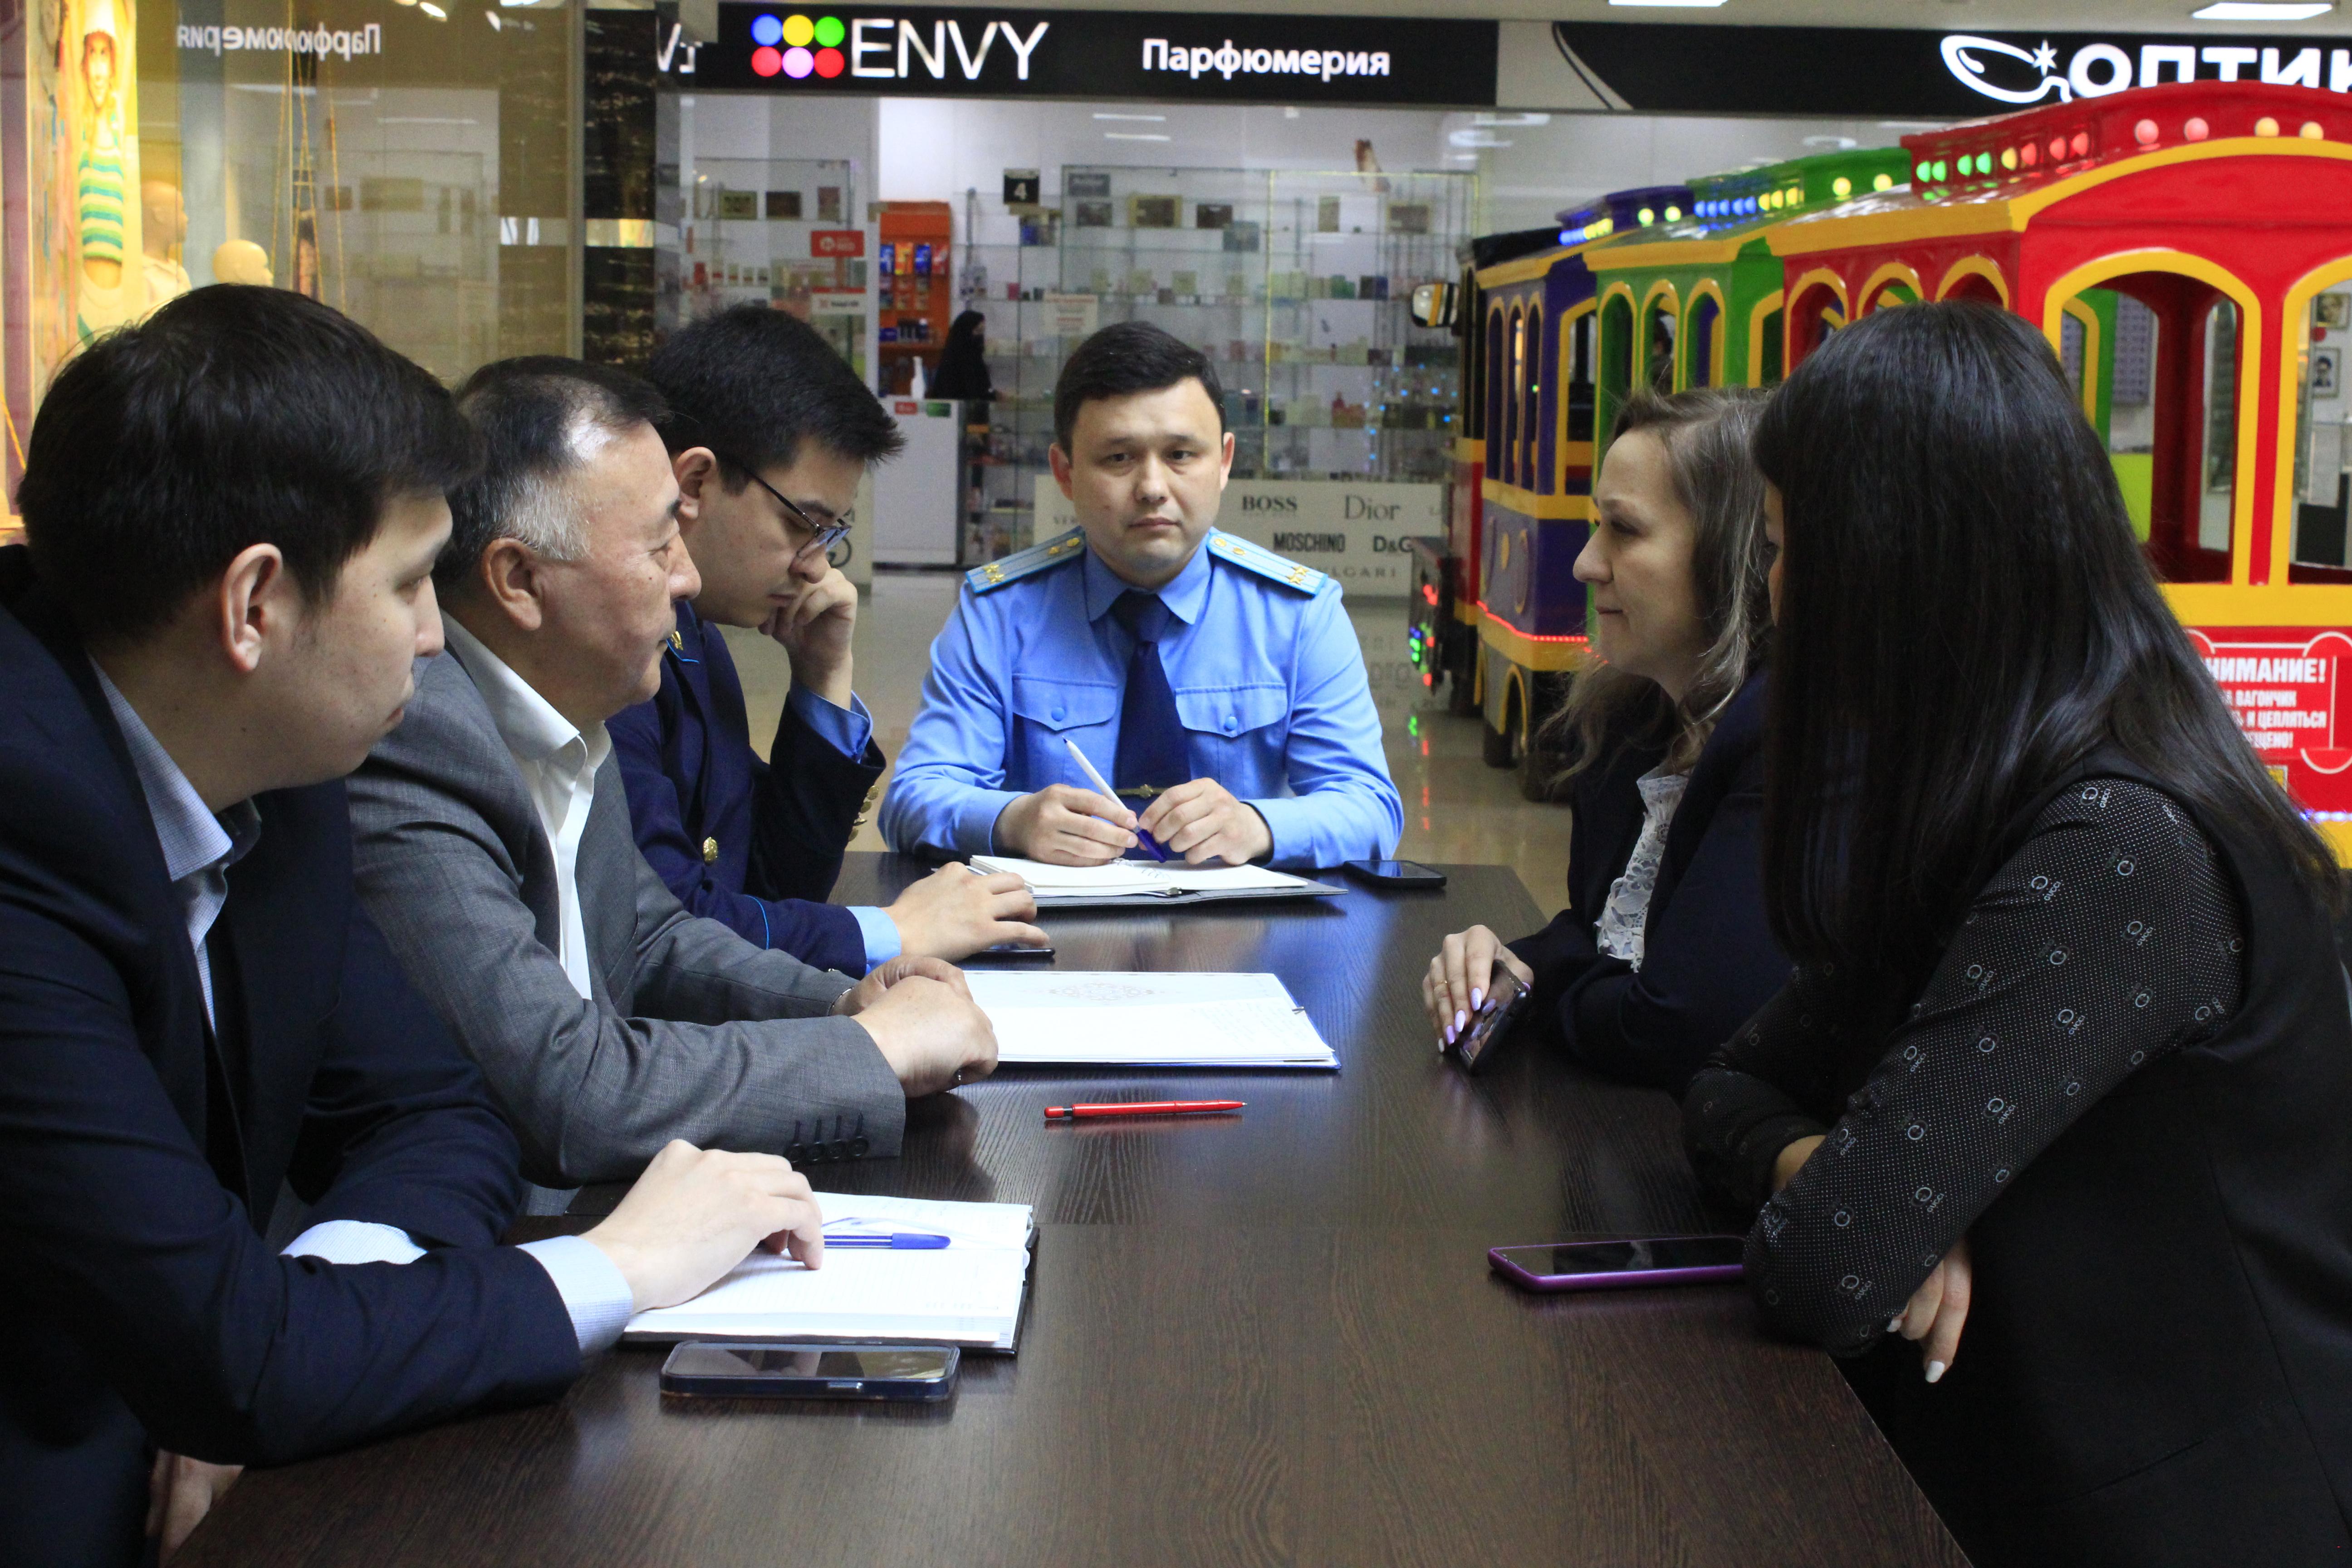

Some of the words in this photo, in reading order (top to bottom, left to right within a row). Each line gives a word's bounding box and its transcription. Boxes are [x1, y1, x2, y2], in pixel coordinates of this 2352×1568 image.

[852, 19, 1049, 79] ENVY
[1143, 39, 1390, 82] Парфюмерия
[1242, 495, 1298, 510] BOSS
[1344, 495, 1401, 520] Dior
[1273, 532, 1346, 553] MOSCHINO
[2204, 658, 2326, 683] НИМАНИЕ!
